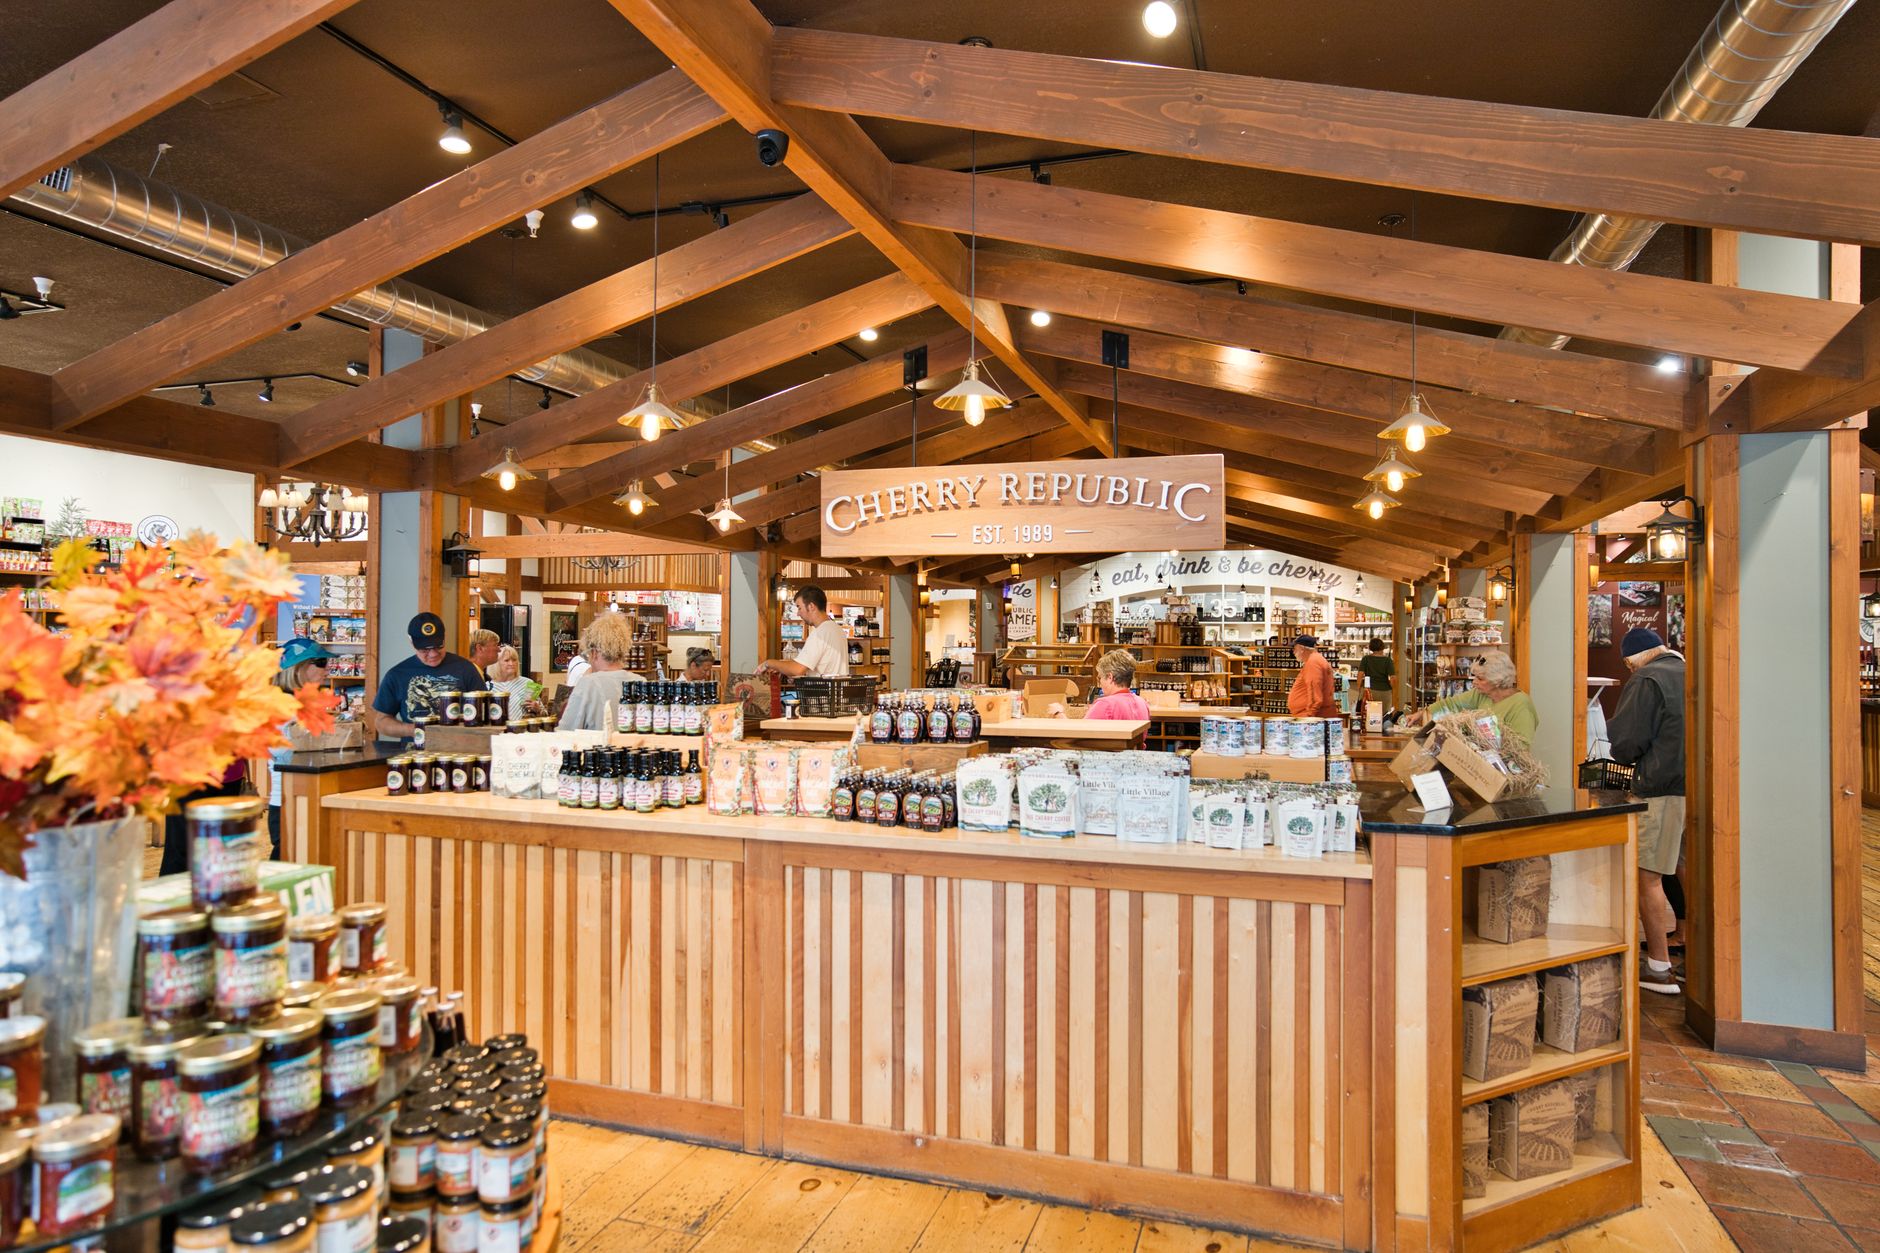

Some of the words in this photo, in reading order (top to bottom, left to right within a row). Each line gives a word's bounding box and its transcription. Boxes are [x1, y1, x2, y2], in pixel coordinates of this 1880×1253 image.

[825, 474, 985, 532] CHERRY
[998, 472, 1211, 523] REPUBLIC
[972, 524, 1006, 544] EST.
[1013, 523, 1054, 543] 1989
[1111, 562, 1149, 586] eat,
[1155, 556, 1213, 577] drink
[1218, 556, 1231, 574] &
[1237, 556, 1264, 574] be
[1268, 559, 1342, 592] cherry
[1210, 598, 1237, 618] 35
[1621, 611, 1660, 625] Magical
[1121, 788, 1141, 796] Little
[1143, 788, 1171, 797] Village
